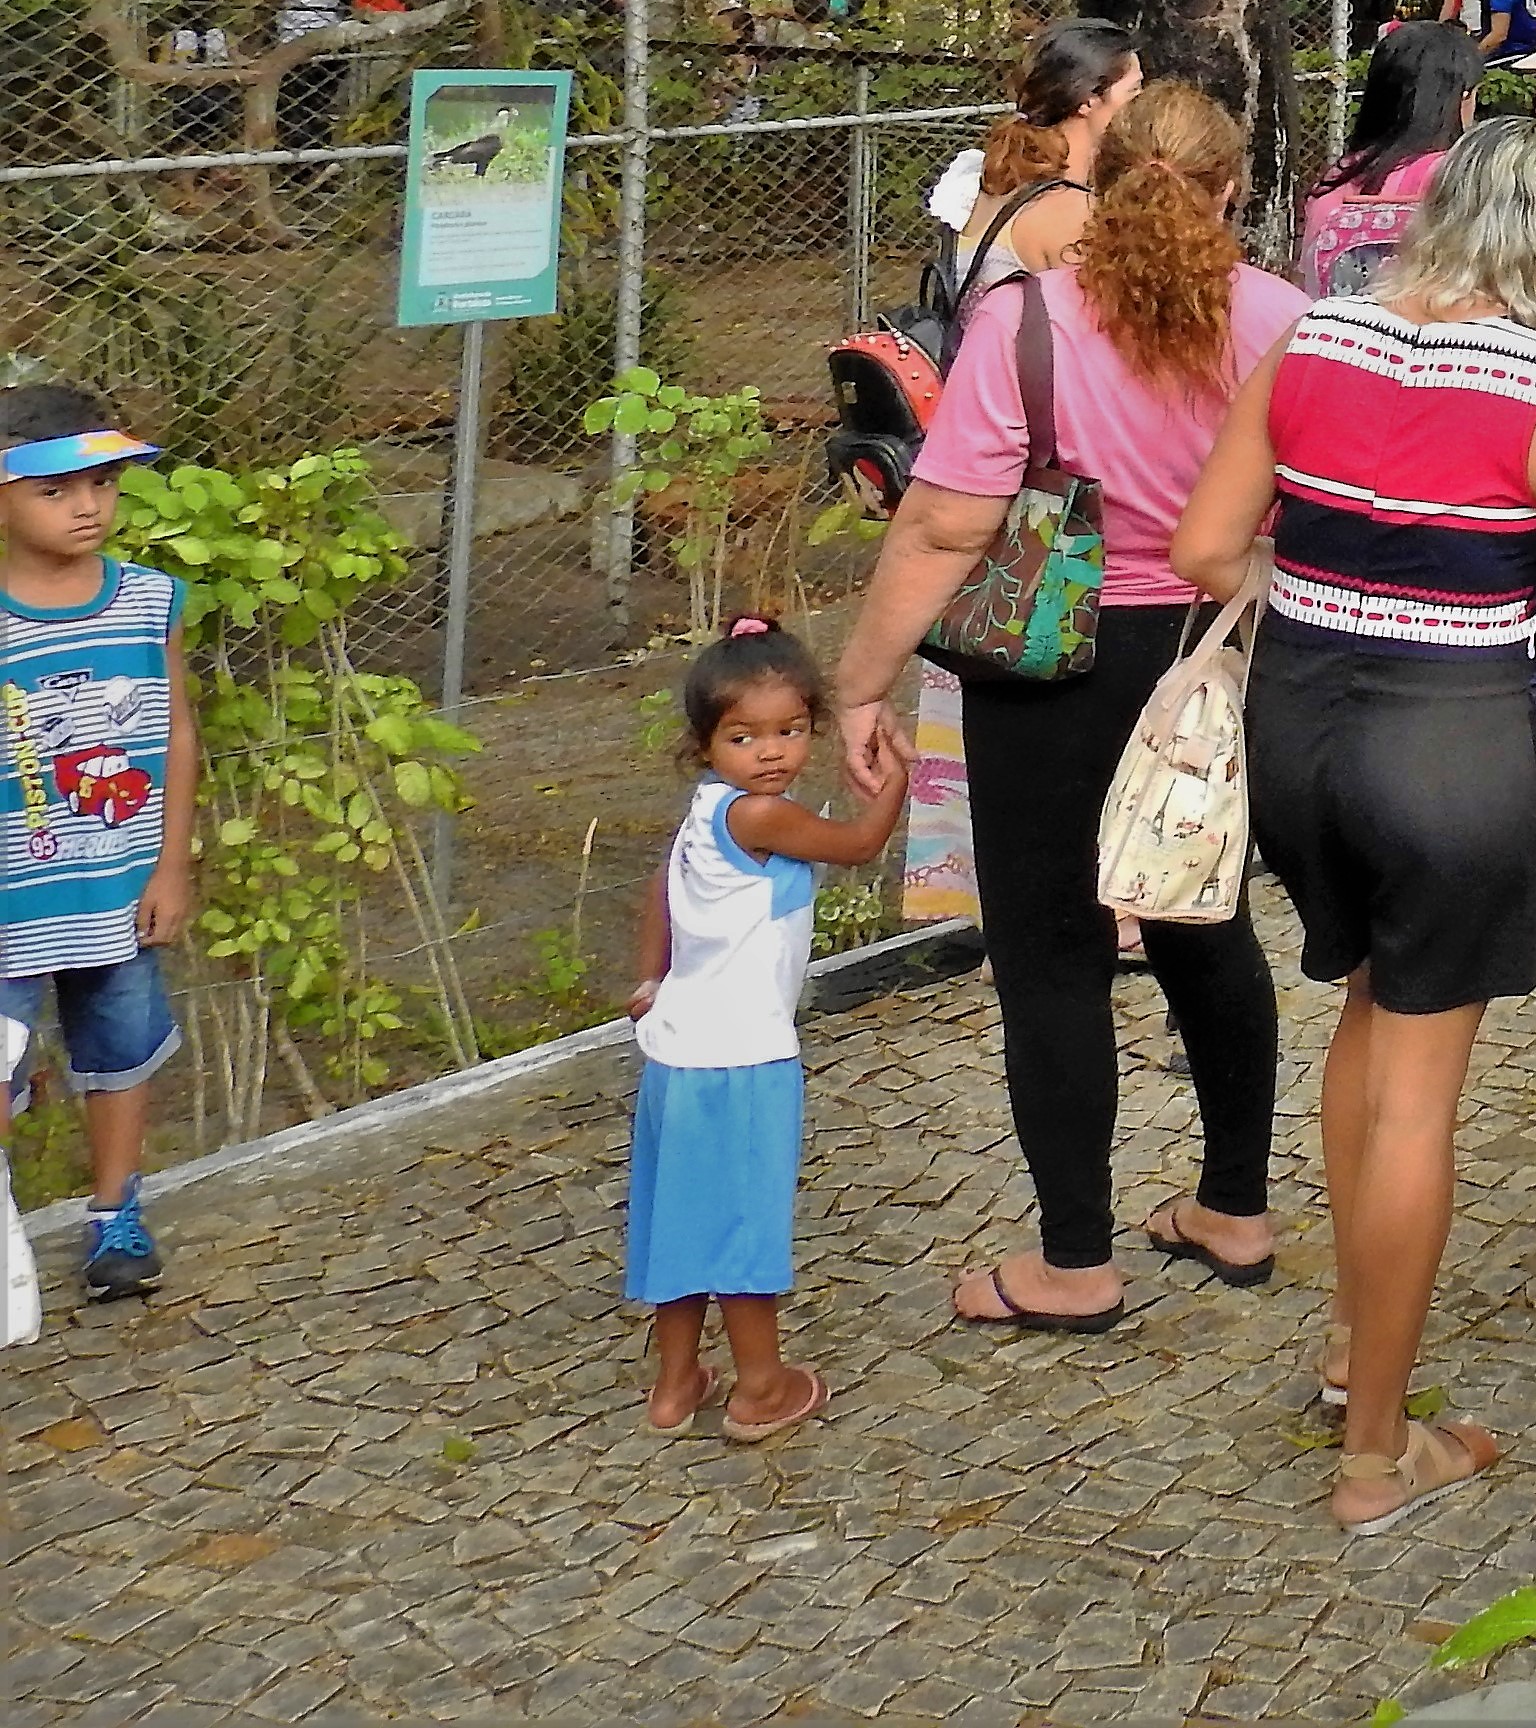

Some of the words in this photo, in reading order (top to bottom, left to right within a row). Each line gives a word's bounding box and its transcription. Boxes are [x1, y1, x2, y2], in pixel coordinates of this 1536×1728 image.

[2, 681, 31, 733] CUP
[13, 737, 48, 830] PISTON
[31, 833, 55, 858] 95
